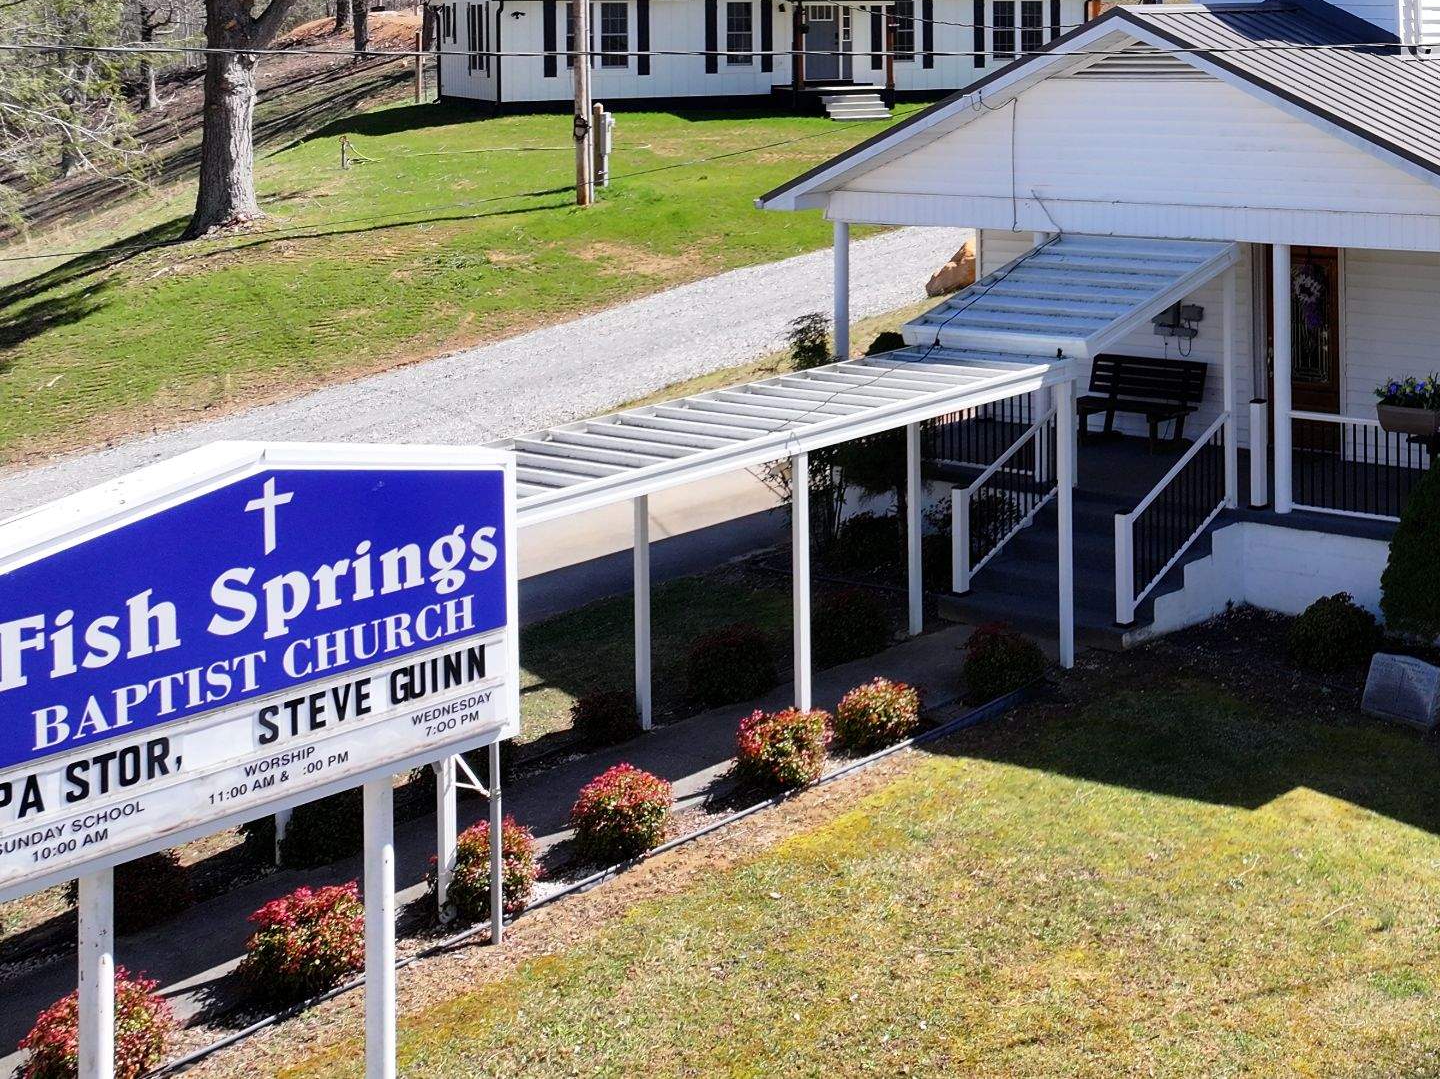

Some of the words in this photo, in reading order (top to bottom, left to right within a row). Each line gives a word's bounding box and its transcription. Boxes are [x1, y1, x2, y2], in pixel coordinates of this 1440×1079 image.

[0, 588, 181, 692] Fish
[207, 524, 497, 640] Springs
[31, 650, 266, 751] BAPTIST
[283, 595, 476, 678] CHURCH
[258, 678, 371, 745] STEVE
[390, 644, 486, 705] GUINN
[412, 691, 492, 725] WEDNESDAY
[425, 718, 456, 737] 7:00
[461, 710, 479, 725] PM
[208, 784, 248, 805] 11:00
[252, 774, 275, 791] AM
[280, 770, 290, 783] &
[328, 751, 349, 768] PM
[244, 746, 315, 777] WORSHIP
[0, 823, 66, 856] UNDAY
[72, 801, 145, 833] SCHOOL
[32, 838, 77, 862] 10:00
[82, 829, 109, 847] AM
